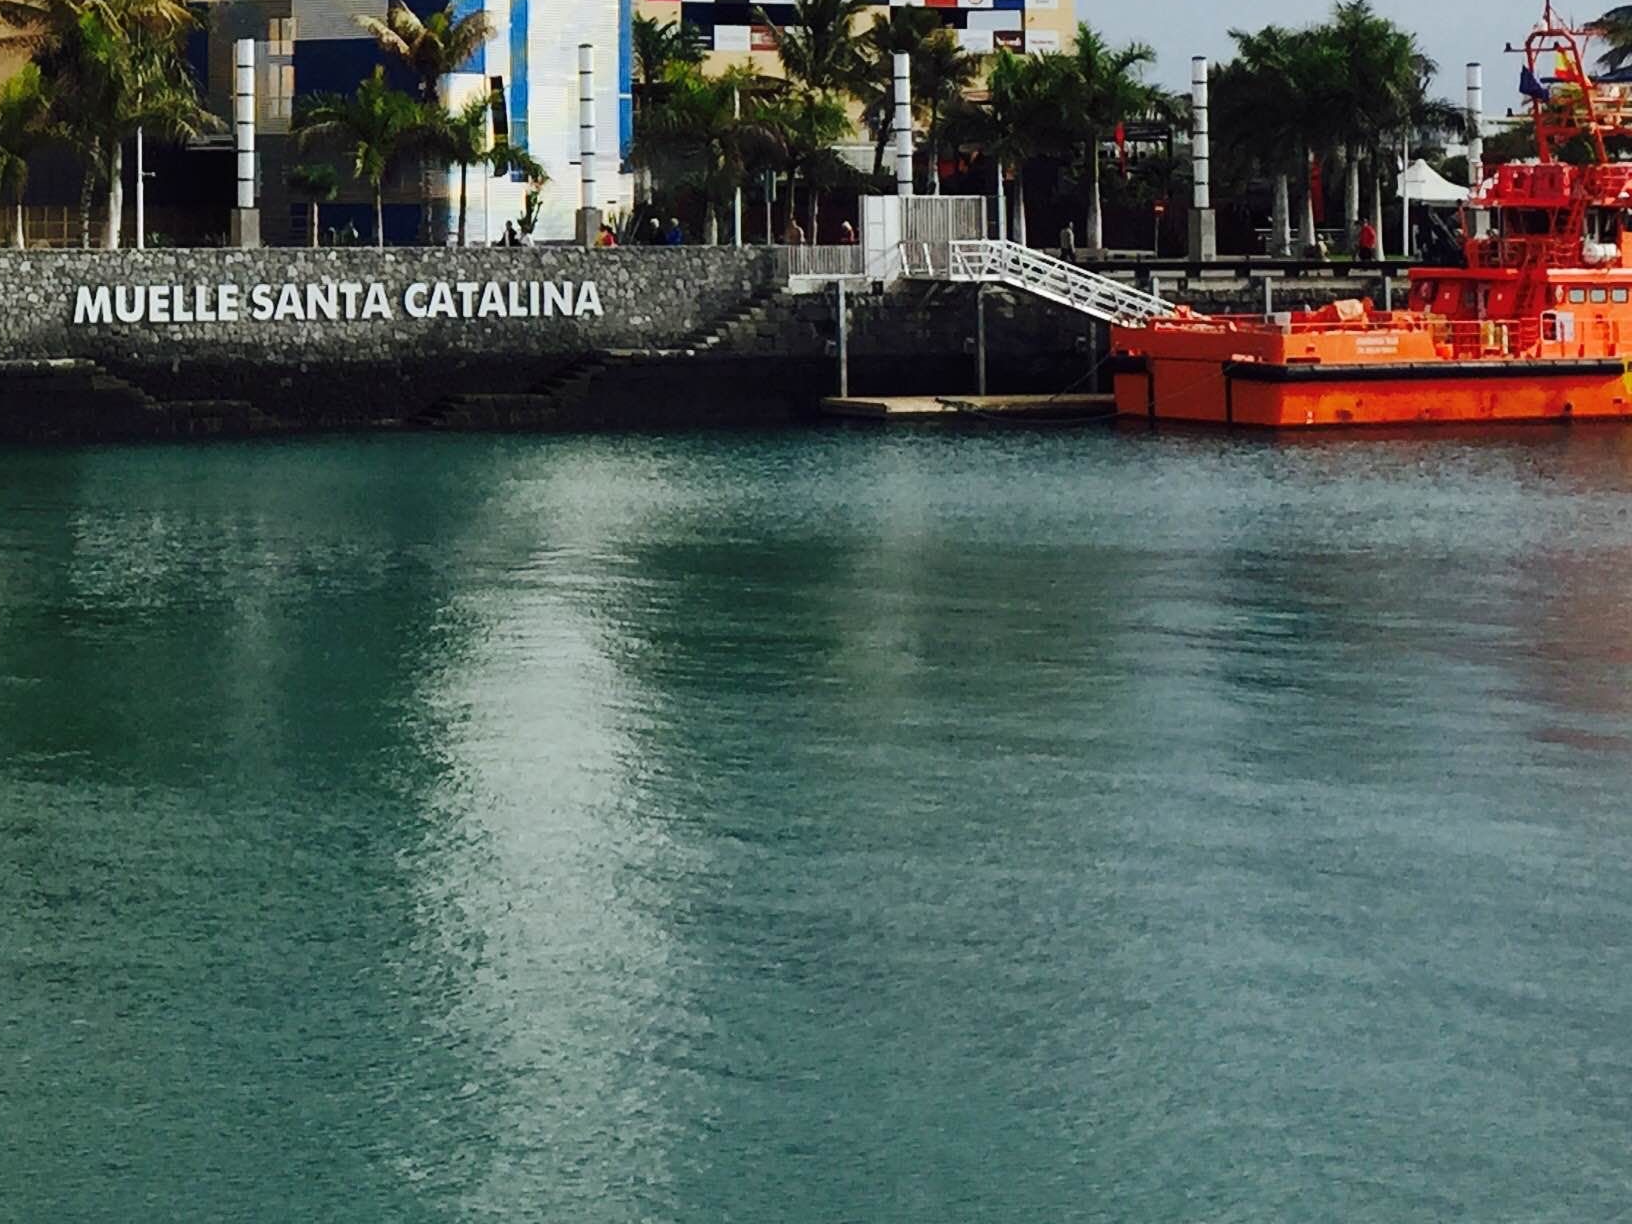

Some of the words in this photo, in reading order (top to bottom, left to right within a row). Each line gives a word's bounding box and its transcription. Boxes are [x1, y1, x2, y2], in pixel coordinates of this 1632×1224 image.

[73, 283, 239, 324] MUELLE
[251, 281, 393, 321] SANTA
[402, 280, 604, 318] CATALINA
